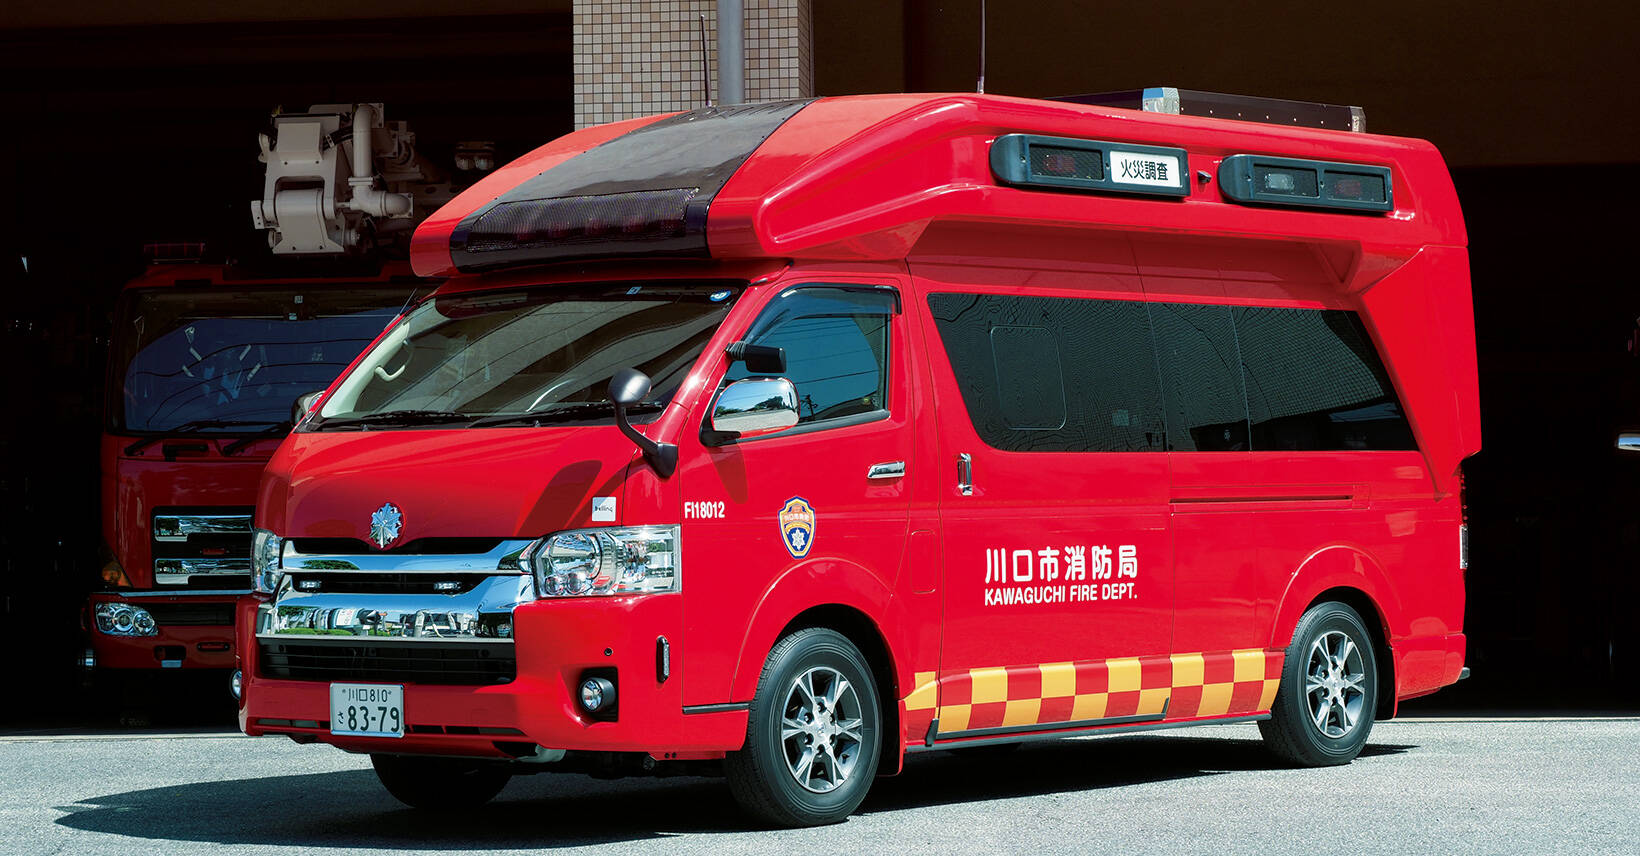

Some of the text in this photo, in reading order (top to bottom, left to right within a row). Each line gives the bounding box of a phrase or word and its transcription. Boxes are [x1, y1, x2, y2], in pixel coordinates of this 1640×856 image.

[1120, 159, 1168, 181] 火災調査
[684, 501, 725, 519] FI18012
[985, 544, 1138, 584] 川口市消防局
[985, 582, 1138, 606] KAWAGUCHI FIRE DEPT.
[348, 705, 400, 732] 83-79
